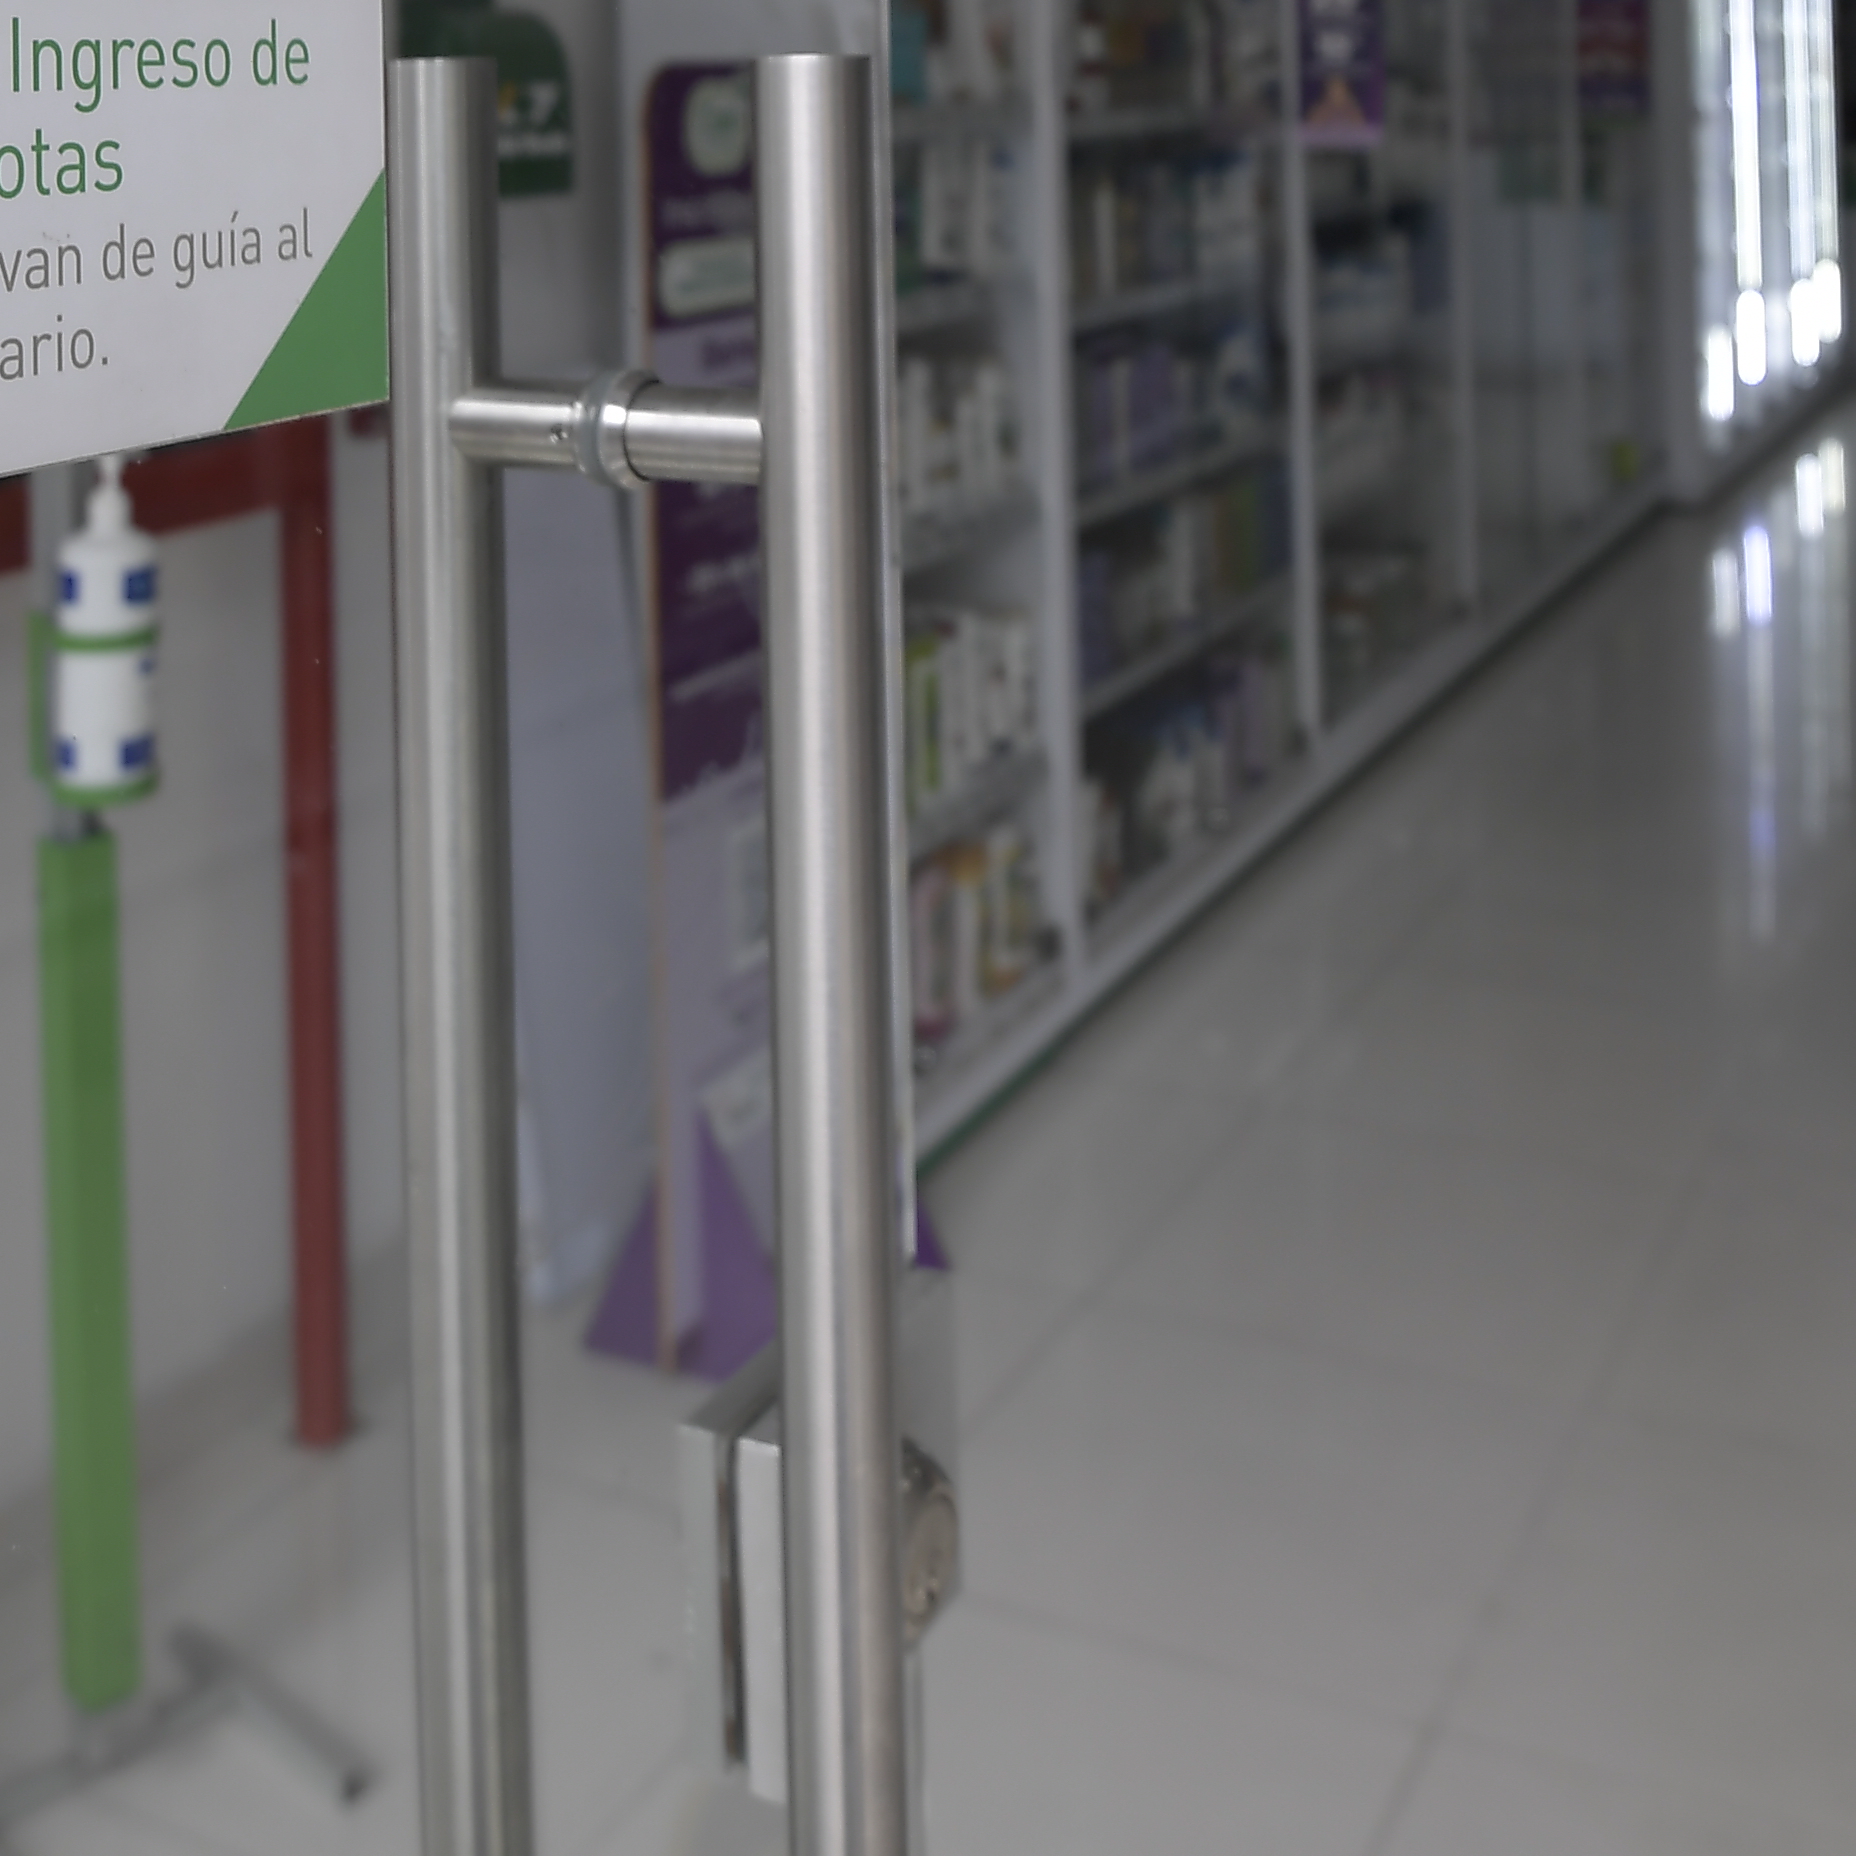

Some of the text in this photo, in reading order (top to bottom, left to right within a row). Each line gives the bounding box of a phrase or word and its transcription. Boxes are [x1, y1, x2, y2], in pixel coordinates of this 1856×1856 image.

[10, 16, 232, 114] Ingreso
[251, 17, 310, 87] de
[101, 222, 155, 282] de
[172, 209, 262, 290] guía
[277, 205, 313, 262] al
